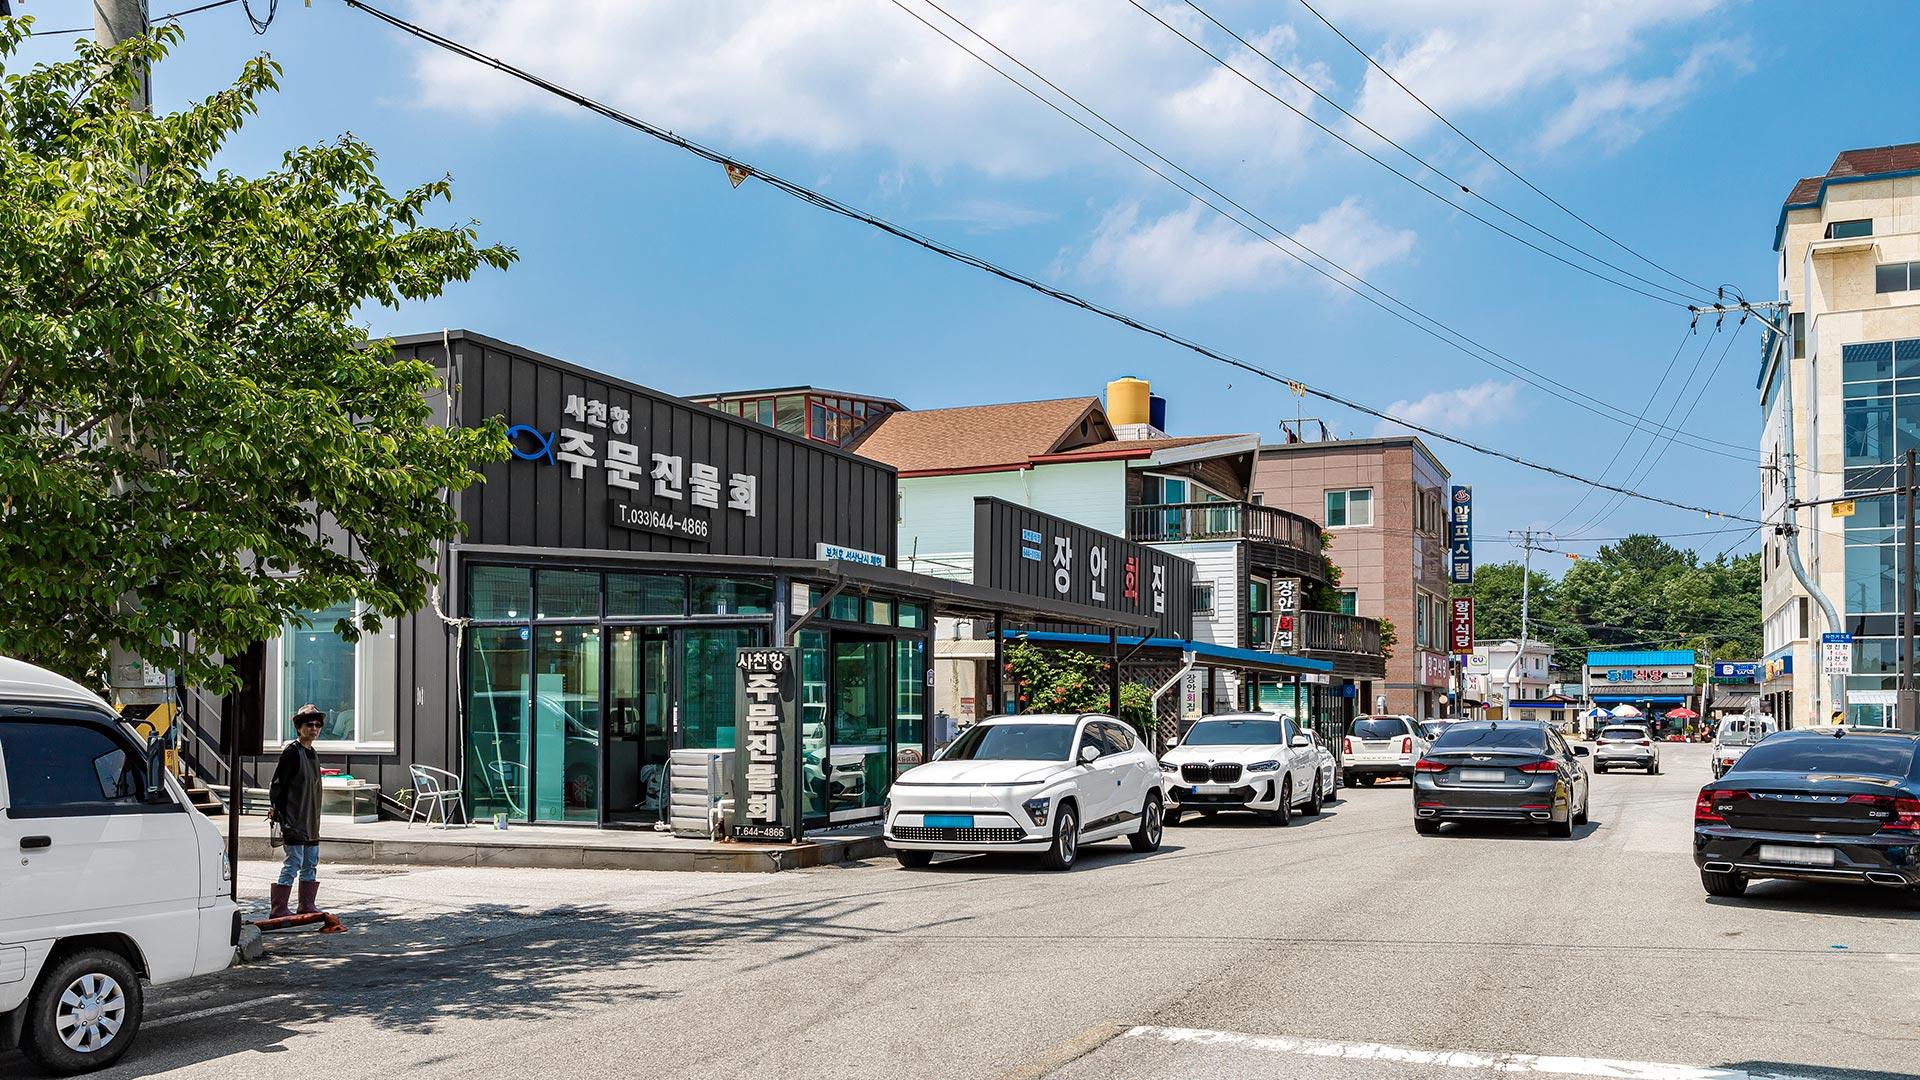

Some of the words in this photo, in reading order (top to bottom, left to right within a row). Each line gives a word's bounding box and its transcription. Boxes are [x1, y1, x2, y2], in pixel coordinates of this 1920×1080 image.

[564, 394, 630, 434] 사천항
[557, 428, 756, 517] 주문진물회
[619, 504, 708, 537] T.033)644-4866
[1454, 505, 1470, 580] 알프스텔
[1053, 536, 1165, 613] 장안회집
[1278, 580, 1294, 647] 장안회집
[1455, 600, 1470, 647] 항구식당
[737, 652, 785, 671] 사천항
[1606, 669, 1663, 683] 동해식당
[1186, 673, 1197, 712] 장안회집
[745, 673, 779, 823] 주문진물회
[1758, 793, 1837, 801] VOLVO
[735, 826, 785, 838] T.644-4866
